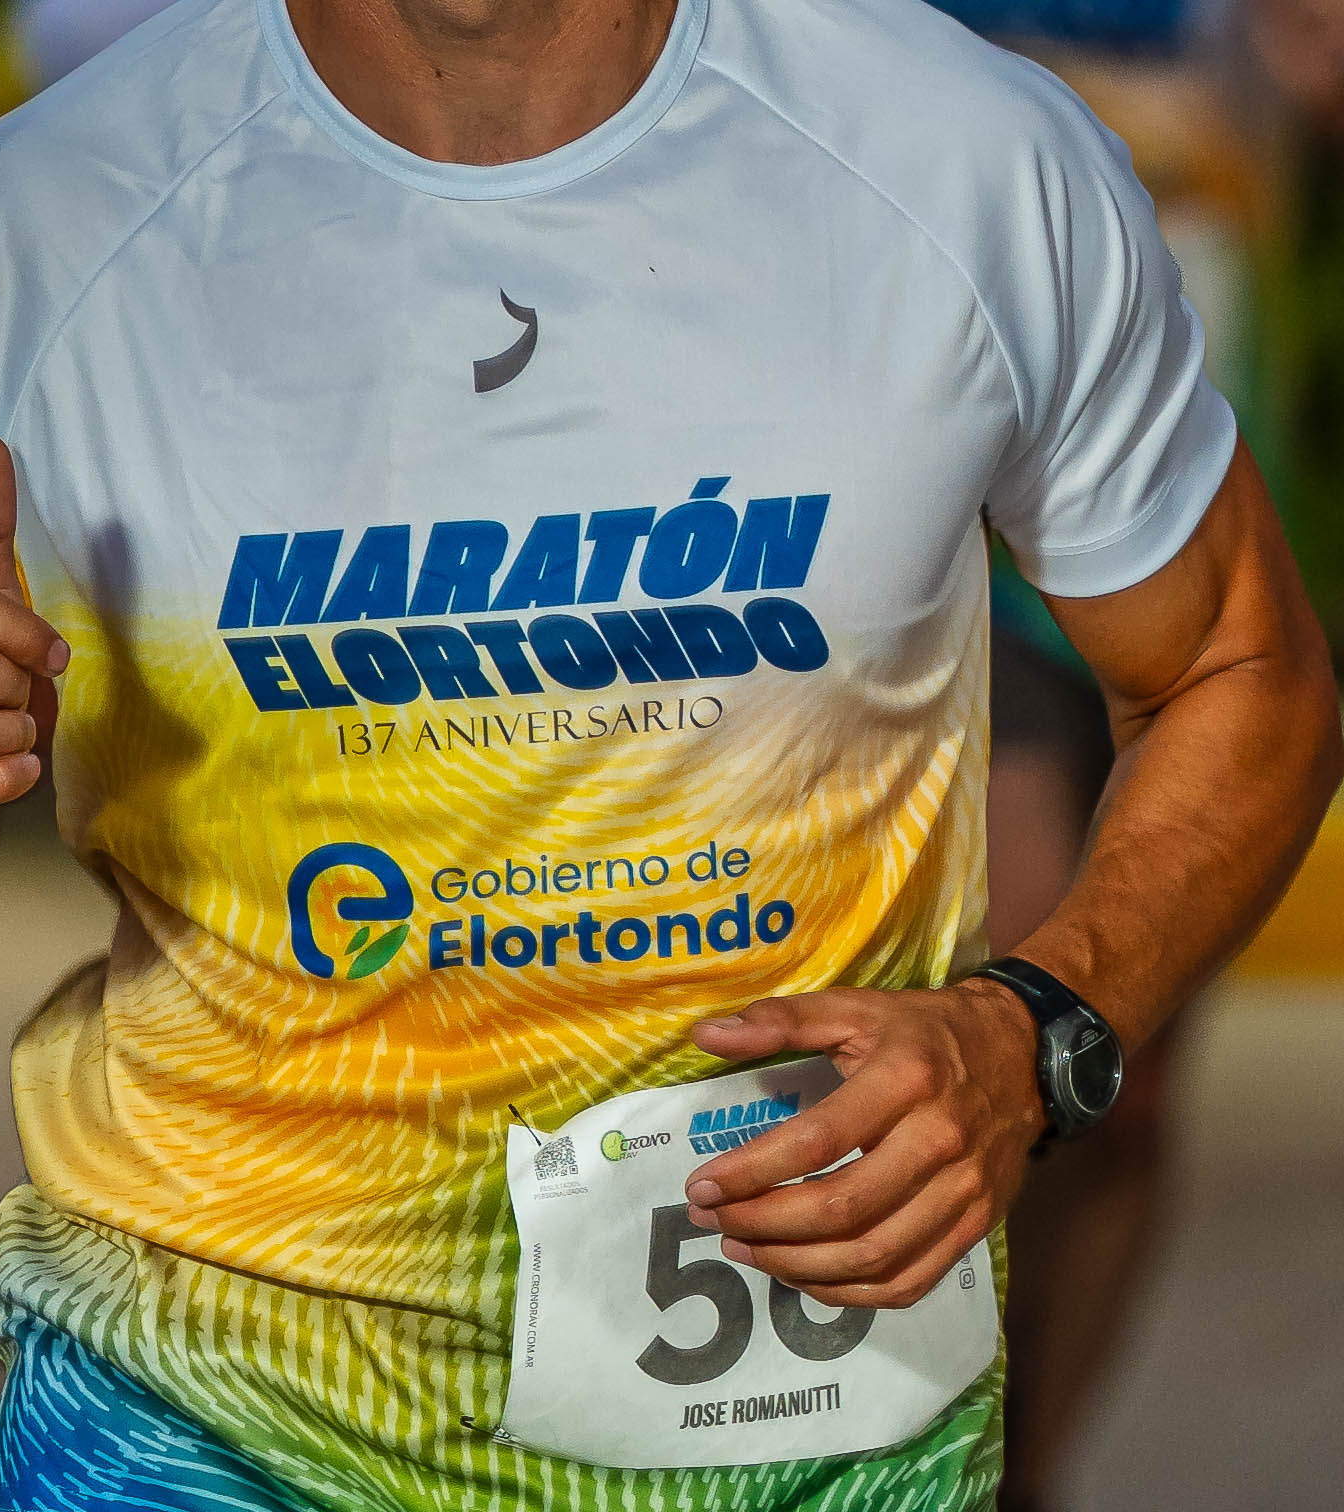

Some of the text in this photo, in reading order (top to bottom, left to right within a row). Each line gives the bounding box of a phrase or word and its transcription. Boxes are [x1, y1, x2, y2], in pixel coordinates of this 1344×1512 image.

[217, 476, 830, 629] MARATÓN
[223, 596, 830, 712] ELORTONDO
[337, 696, 724, 756] 137 ANIVERSARIO
[431, 841, 751, 904] Gobierno de
[428, 893, 795, 971] Elortondo
[524, 1242, 542, 1368] WWW.CRONORAV.COM.AR
[679, 1382, 840, 1429] JOSE ROMANUTTI
